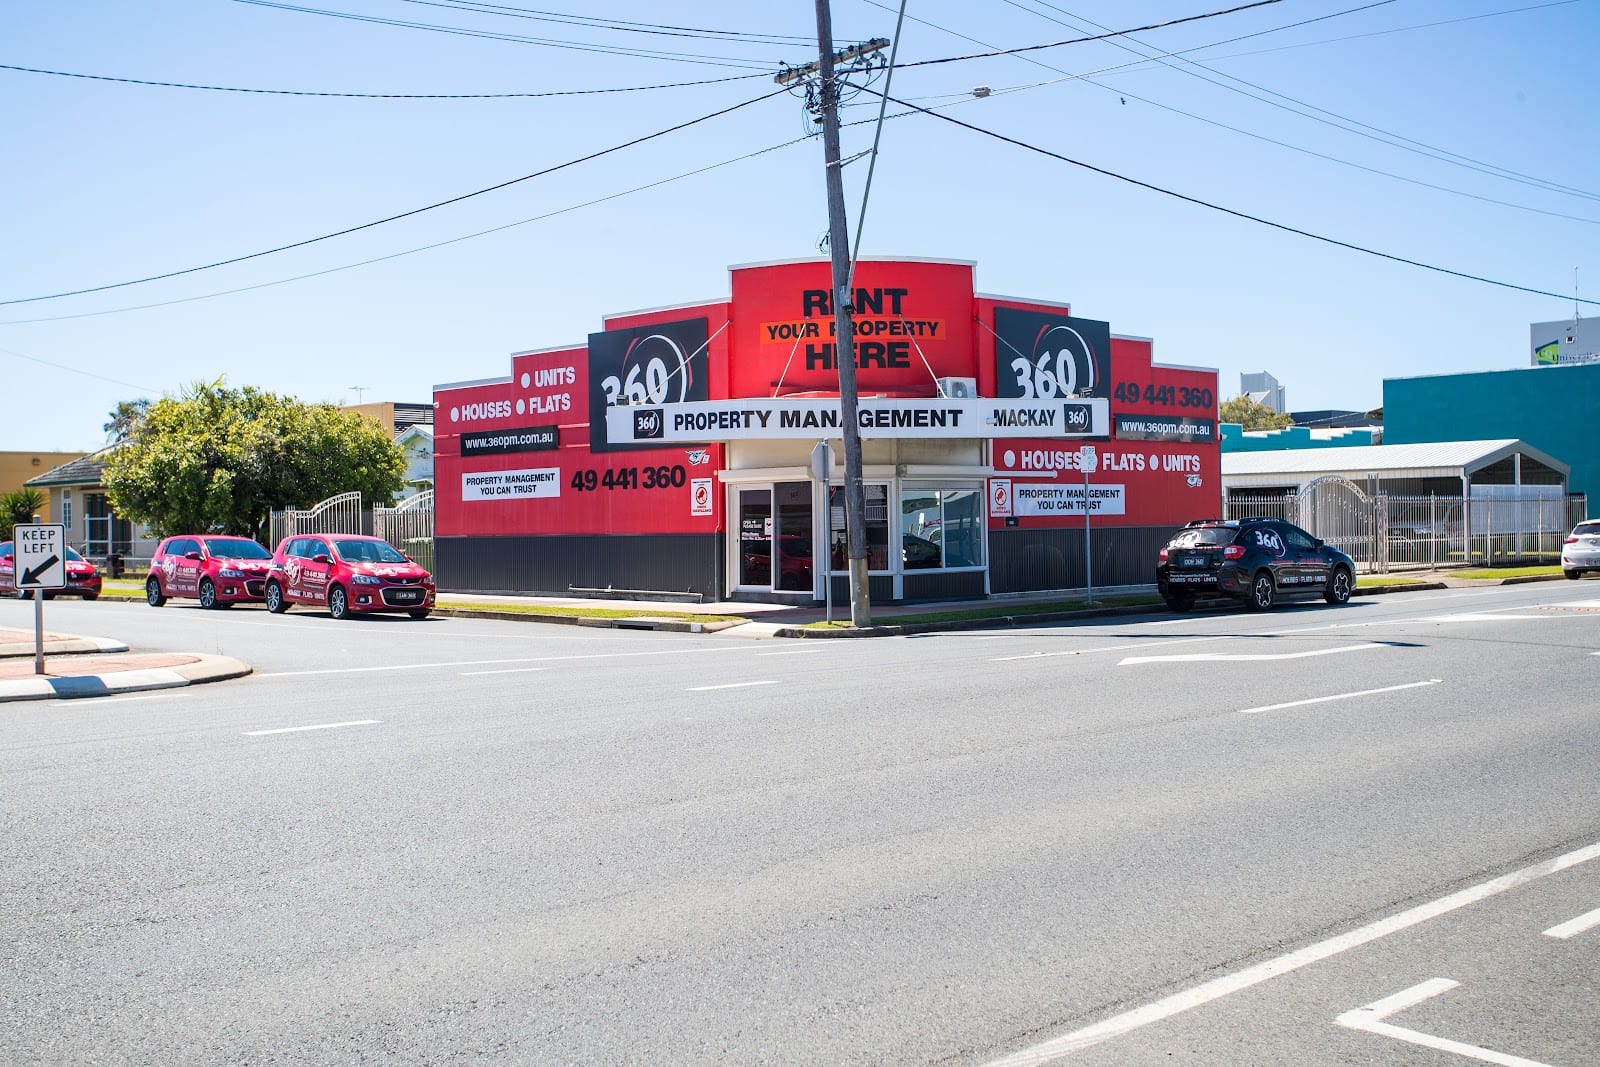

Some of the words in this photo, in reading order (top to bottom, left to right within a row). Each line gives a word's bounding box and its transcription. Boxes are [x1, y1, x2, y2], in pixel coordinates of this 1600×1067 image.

[767, 321, 819, 340] YOUR
[534, 366, 576, 388] UNITS
[601, 357, 669, 407] 360
[1011, 349, 1077, 399] 360
[1114, 382, 1140, 404] 49
[1143, 384, 1175, 406] 441
[1178, 386, 1213, 409] 360
[461, 400, 512, 421] HOUSES
[529, 393, 571, 414] FLATS
[637, 416, 656, 430] 360
[674, 410, 772, 431] PROPERTY
[780, 409, 963, 428] MANGEMENT
[993, 409, 1056, 427] MACKAY
[1068, 411, 1085, 425] 360
[1122, 421, 1210, 436] www.360pm.com.au
[465, 432, 553, 449] www.360pm.com.au
[1021, 450, 1081, 470] HOUSES
[1103, 453, 1145, 471] FLATS
[1163, 455, 1200, 472] UNITS
[466, 475, 503, 486] PROPERTY
[505, 473, 555, 484] MANAGEMENT
[571, 469, 598, 491] 49
[602, 467, 638, 490] 441
[642, 464, 686, 489] 360
[480, 487, 496, 496] YOU
[496, 486, 511, 495] CAN
[513, 484, 537, 494] TRUST
[1019, 489, 1064, 498] PROPERTY
[1066, 489, 1120, 499] MANGEMENT
[1037, 500, 1055, 510] YOU
[1057, 500, 1073, 510] CAN
[22, 530, 56, 541] KEEP
[1255, 530, 1279, 550] 360
[24, 543, 54, 554] LEFT
